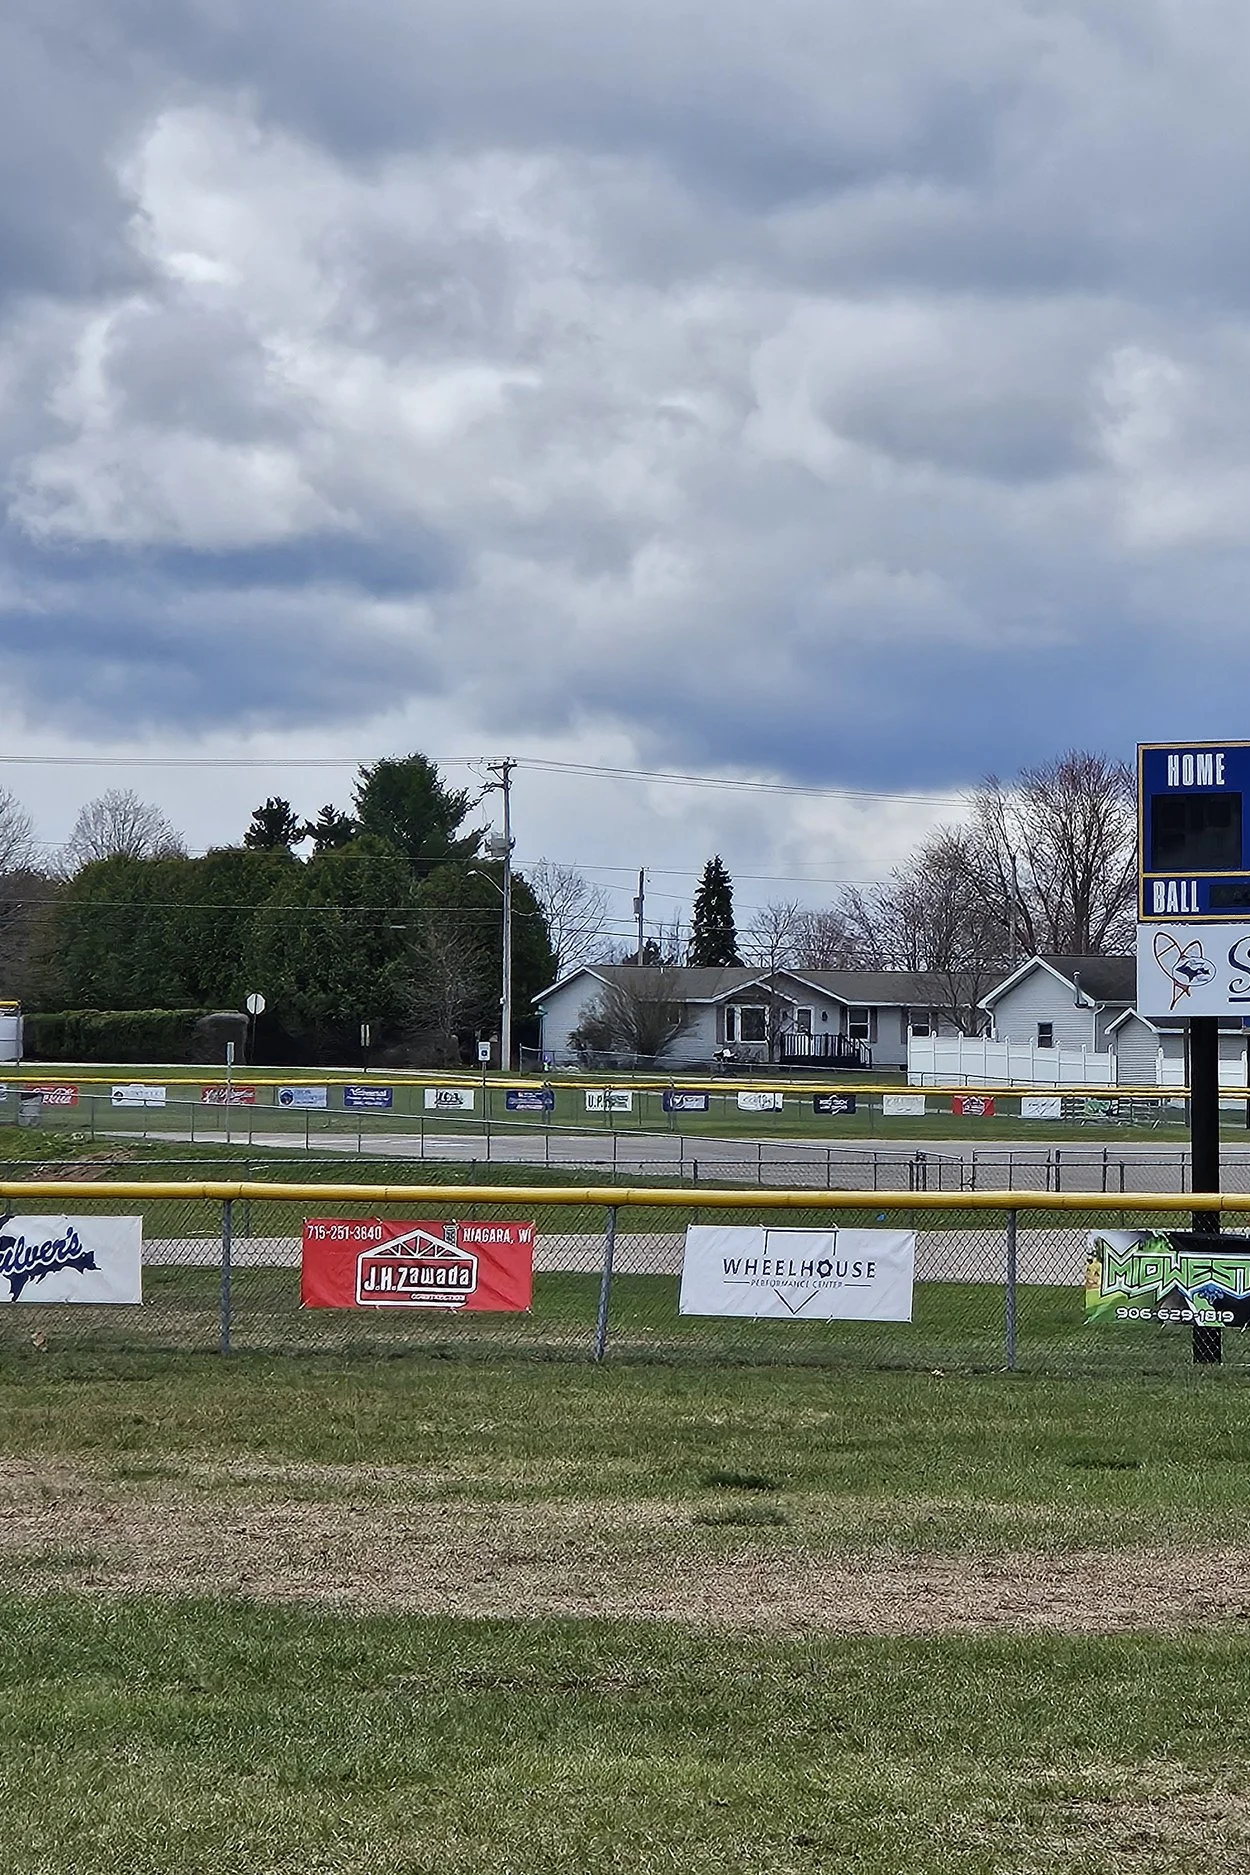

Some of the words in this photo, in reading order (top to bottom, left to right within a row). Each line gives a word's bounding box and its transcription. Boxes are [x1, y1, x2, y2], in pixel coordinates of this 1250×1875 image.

[1167, 753, 1225, 787] HOME
[1153, 880, 1199, 914] BALL
[463, 1228, 514, 1245] NIAGARA,
[518, 1228, 532, 1243] WI
[722, 1258, 877, 1278] WHEELHOUSE
[751, 1279, 809, 1288] PERFORMANCE
[812, 1280, 843, 1289] CENTER
[1116, 1307, 1235, 1323] 906-629-1819
